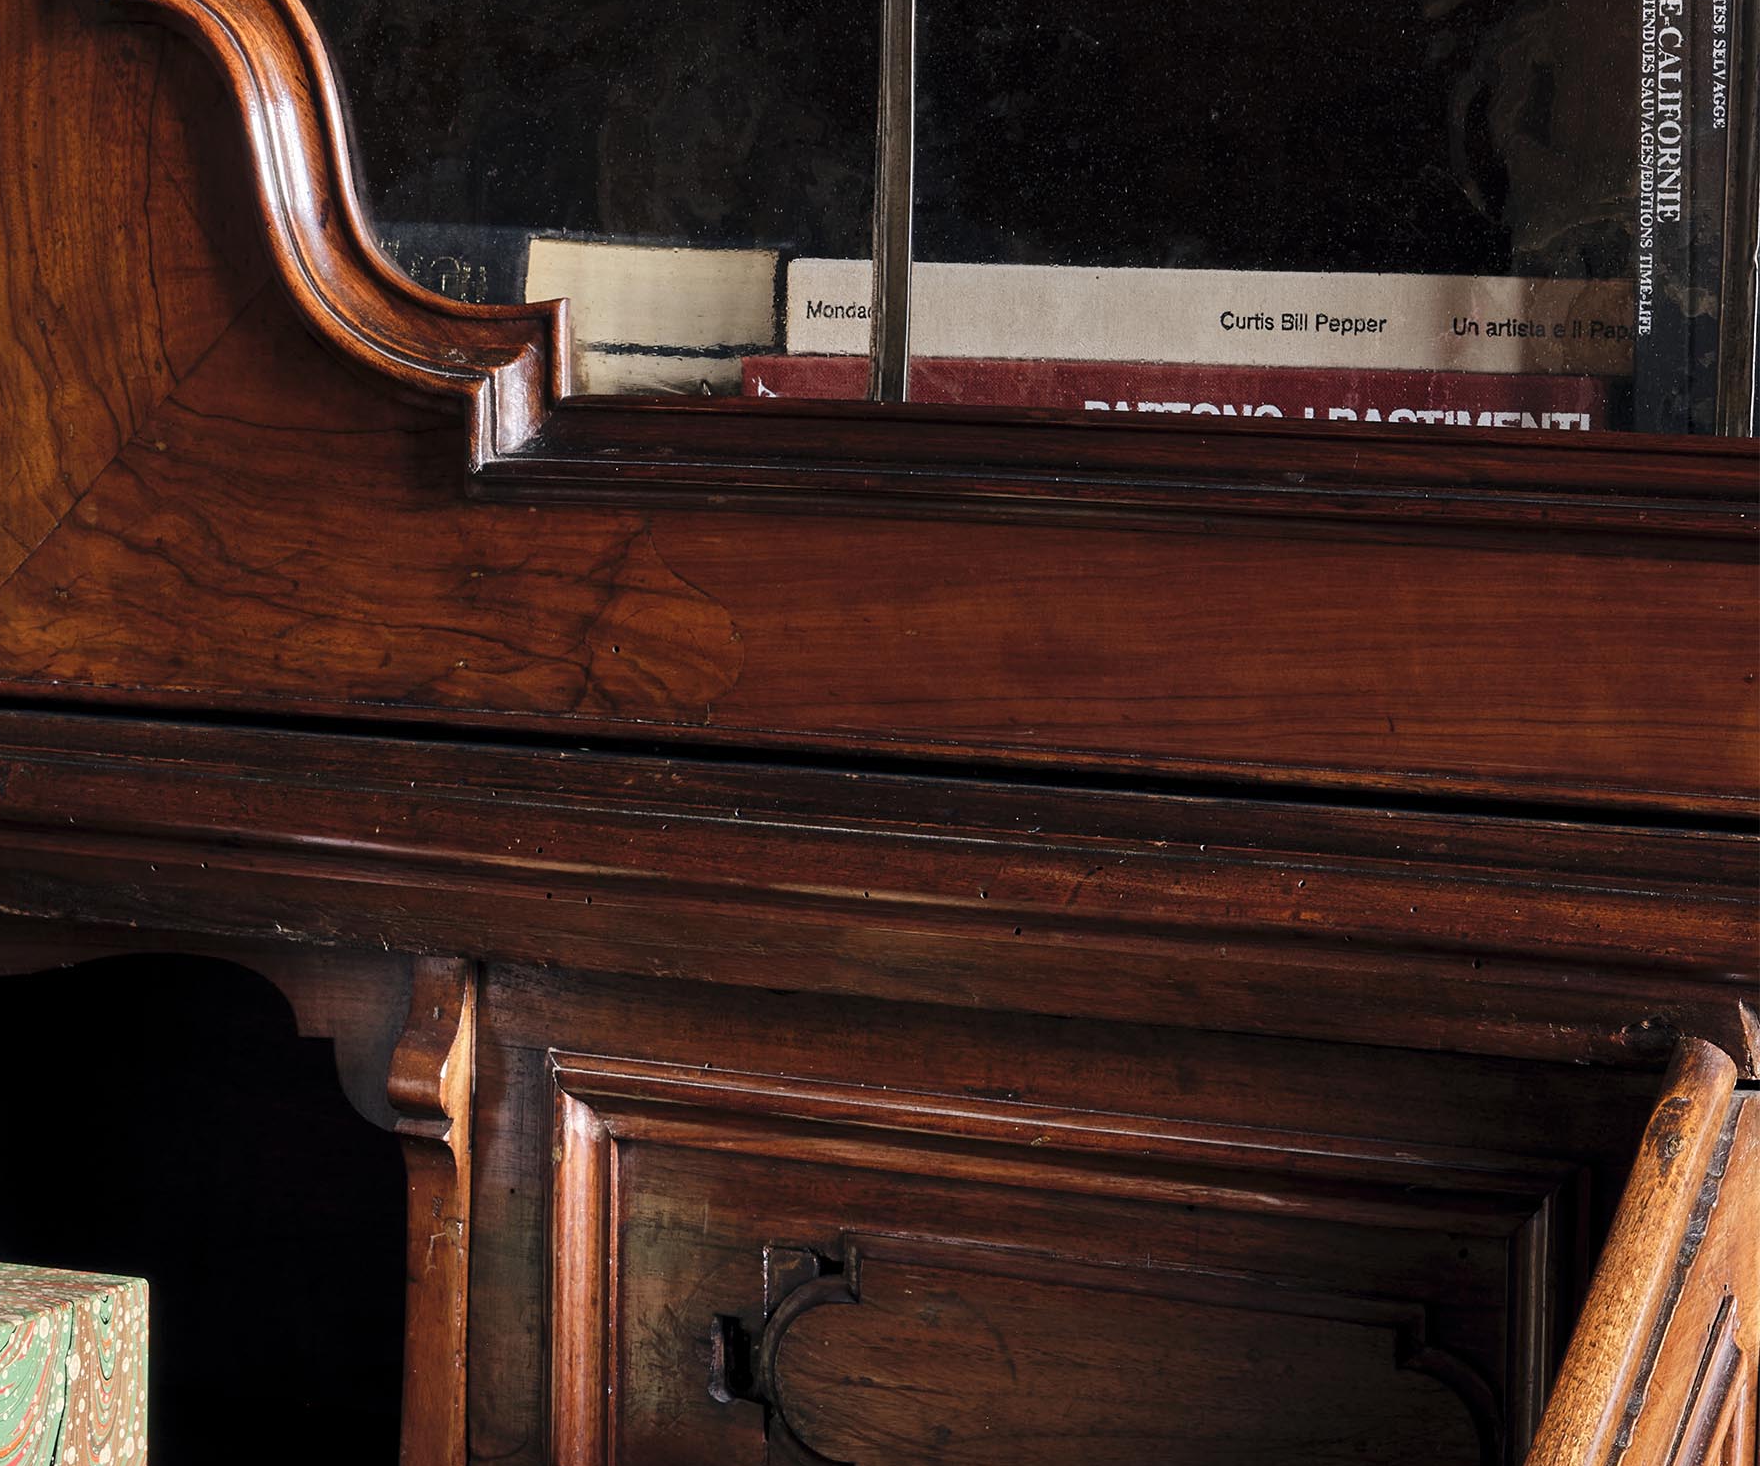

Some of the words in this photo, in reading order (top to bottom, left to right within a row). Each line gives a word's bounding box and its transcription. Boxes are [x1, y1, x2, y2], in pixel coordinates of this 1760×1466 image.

[1711, 38, 1727, 129] SELVAGGE
[1638, 77, 1655, 249] SAUVAGES/EDITIONS
[1219, 310, 1276, 333] Curtis
[1280, 312, 1310, 333] Bill
[1314, 312, 1389, 337] Pepper
[1452, 317, 1480, 337] Un
[1485, 318, 1547, 339] artista
[1553, 323, 1566, 339] e
[1637, 252, 1654, 335] TIME-LIFE
